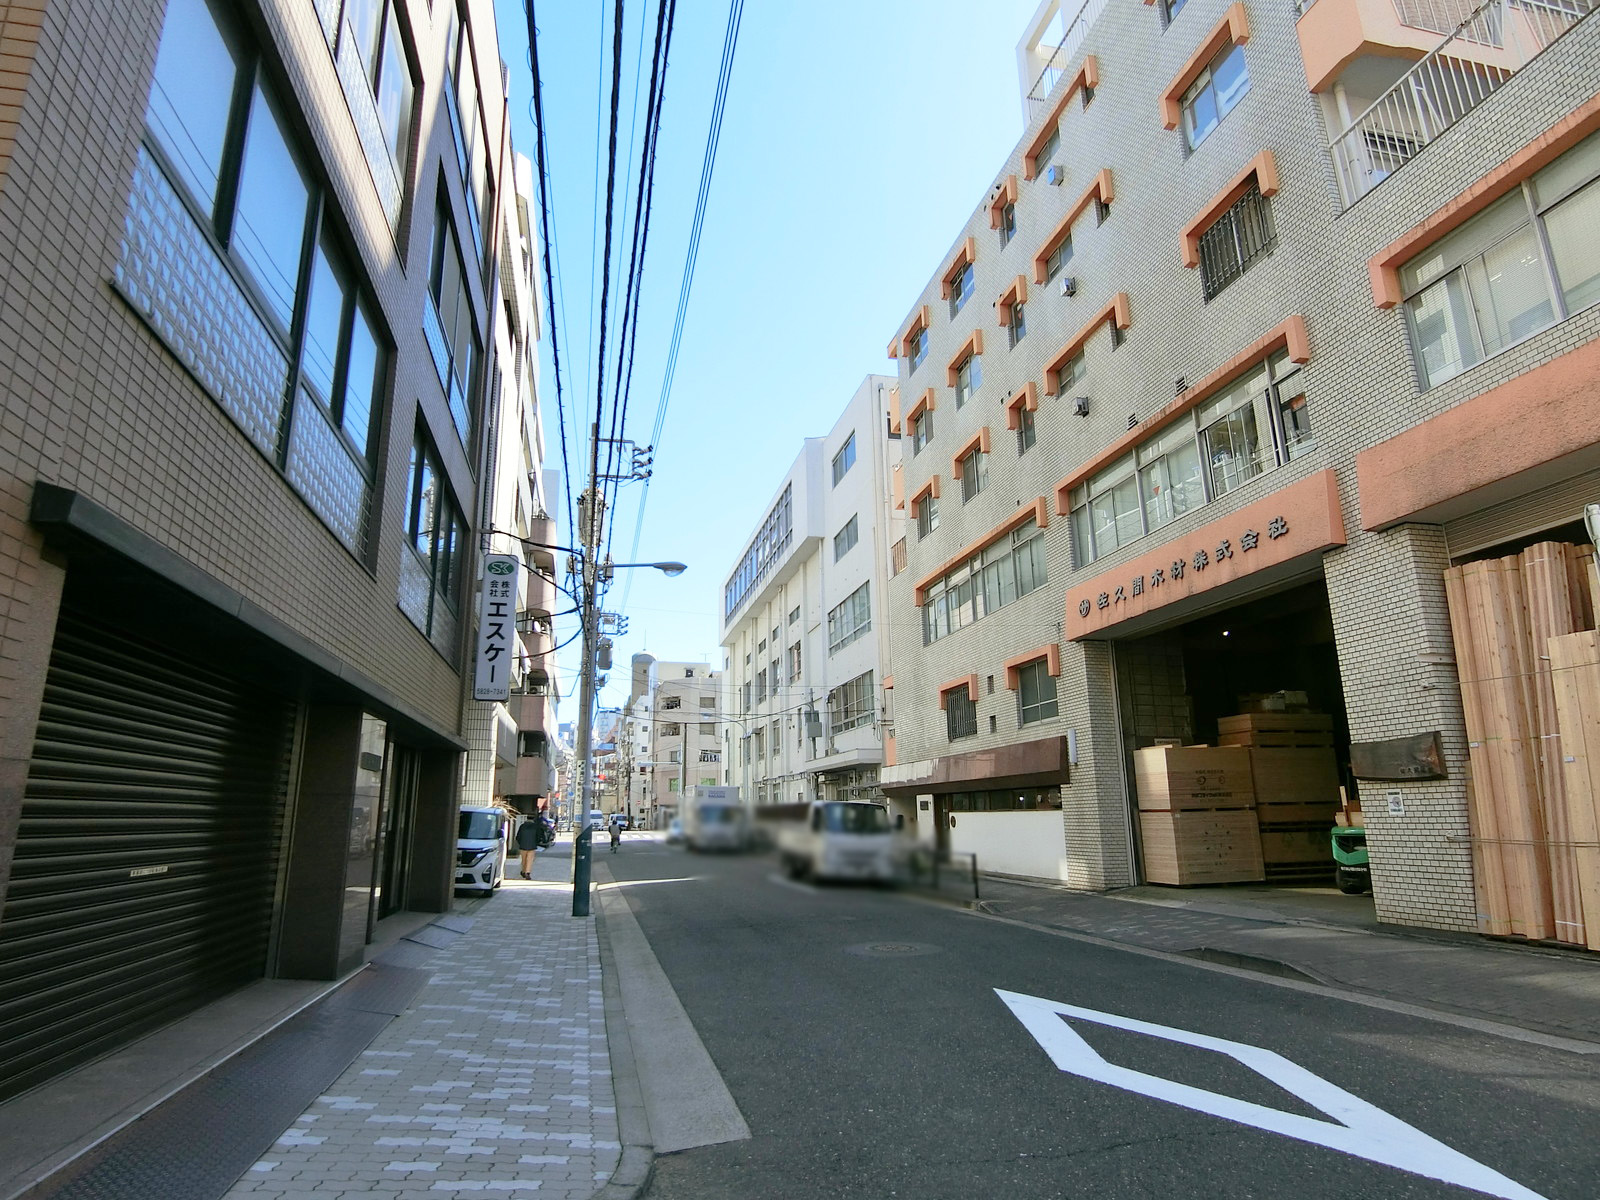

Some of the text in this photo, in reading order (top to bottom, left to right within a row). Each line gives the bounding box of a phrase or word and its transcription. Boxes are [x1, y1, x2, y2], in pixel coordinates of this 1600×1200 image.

[1096, 515, 1289, 610] 佐久間木材株式会社
[485, 602, 508, 683] エスケー
